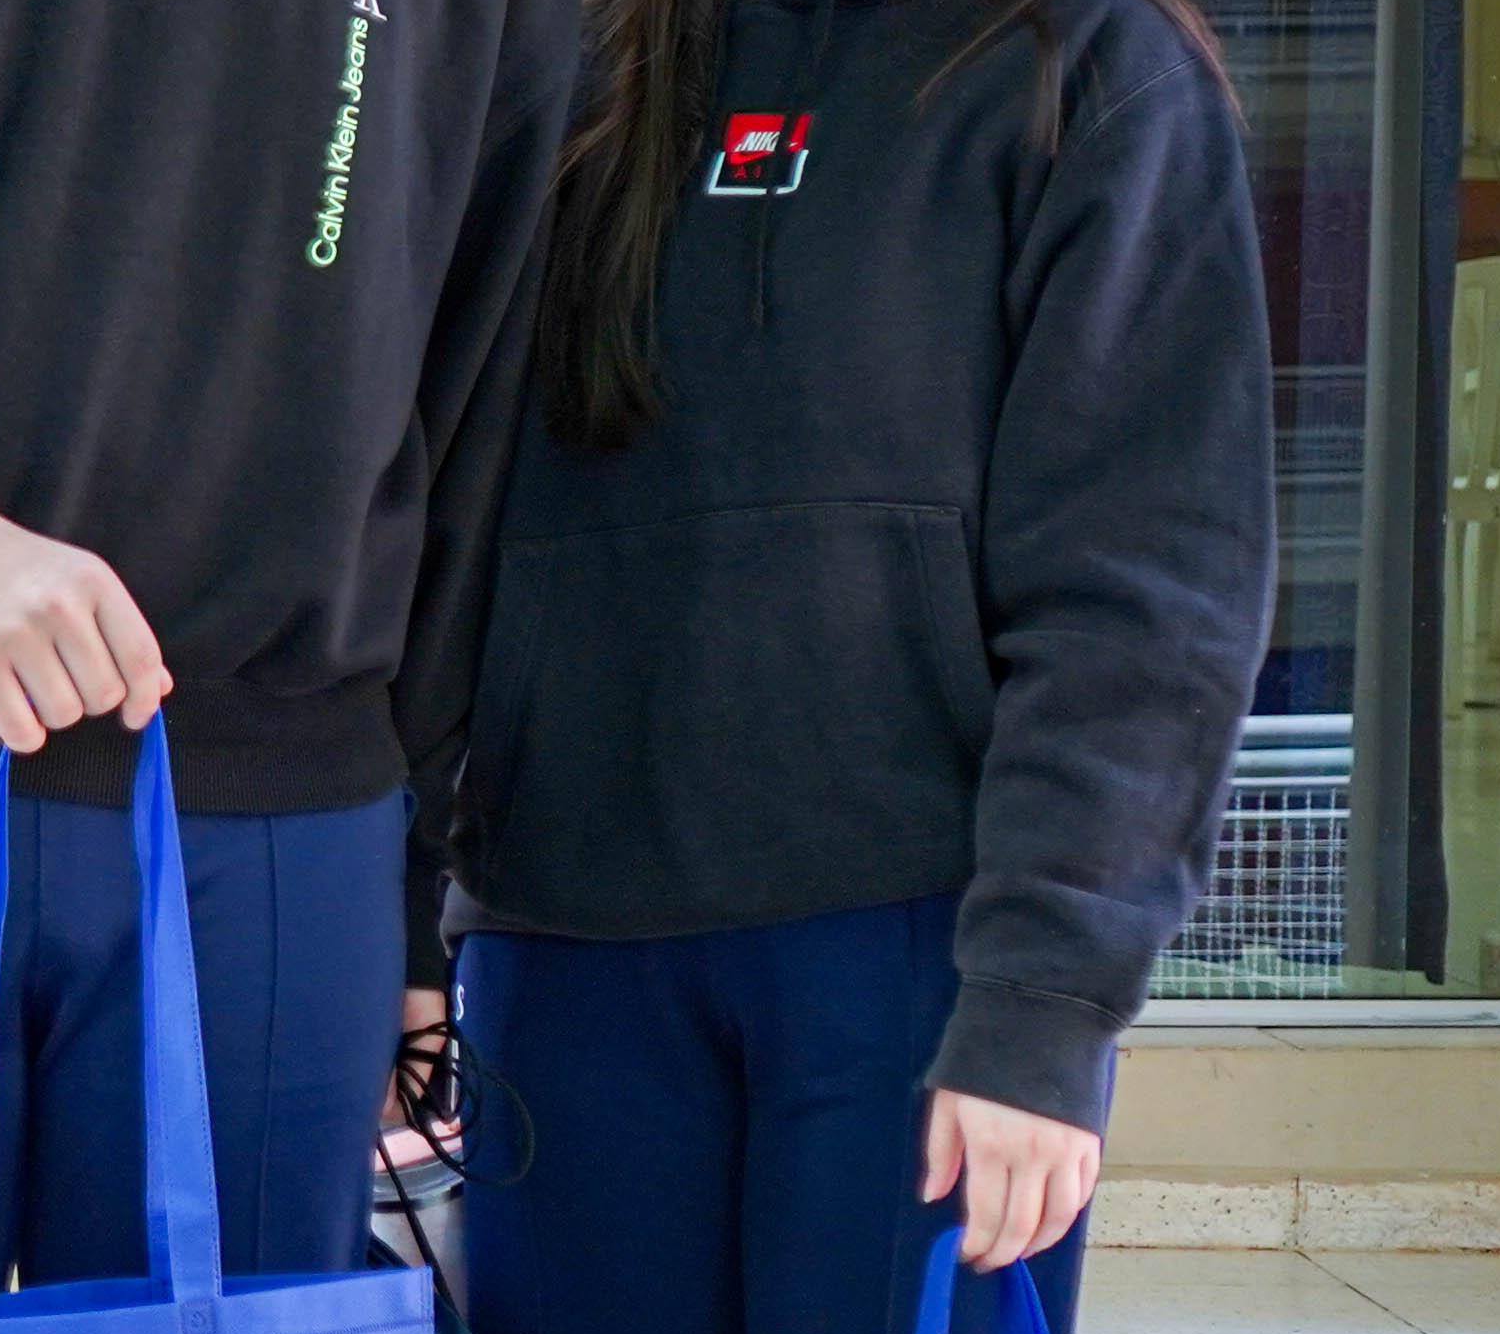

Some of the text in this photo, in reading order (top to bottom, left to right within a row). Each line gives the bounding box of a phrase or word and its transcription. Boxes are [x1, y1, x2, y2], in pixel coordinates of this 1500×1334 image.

[311, 17, 369, 267] Calvin Klein Jeans
[734, 131, 785, 152] NIK
